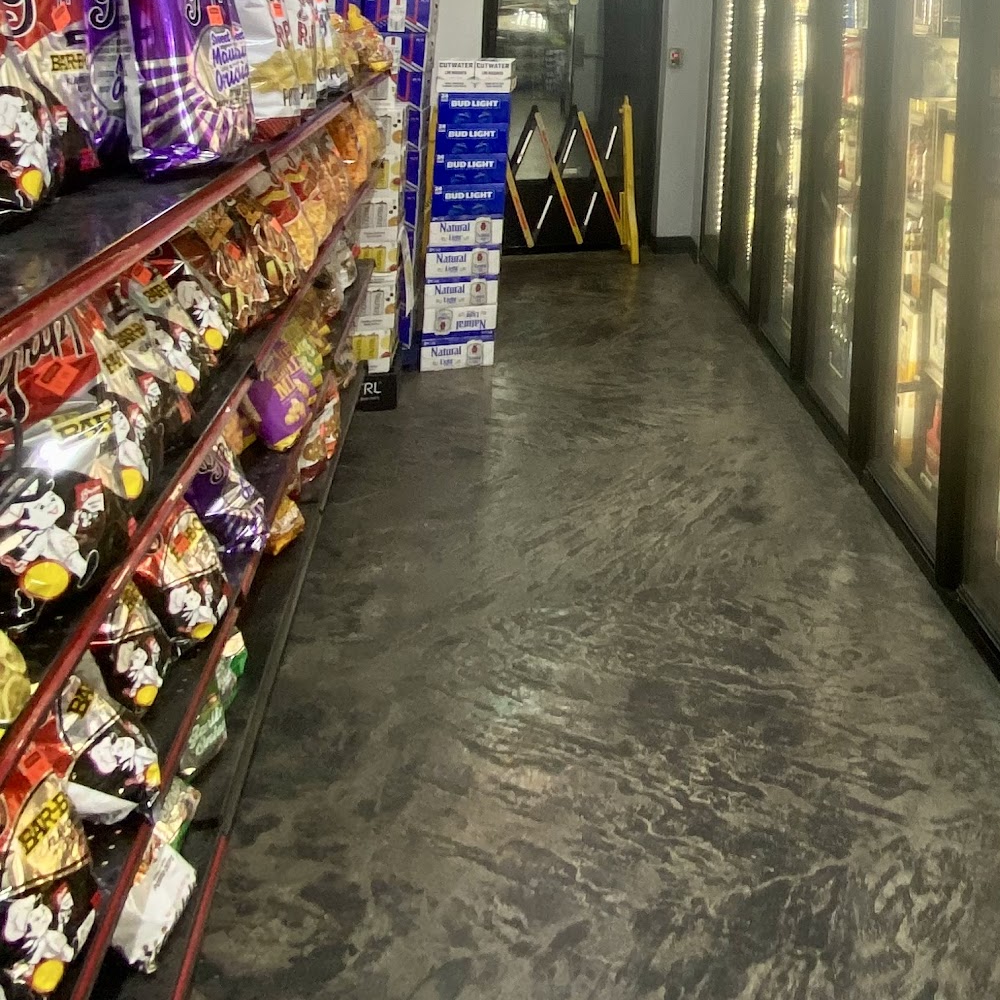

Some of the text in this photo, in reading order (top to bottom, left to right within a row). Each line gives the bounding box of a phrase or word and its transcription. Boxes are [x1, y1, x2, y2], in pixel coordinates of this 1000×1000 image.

[467, 160, 494, 168] LIGHT
[465, 191, 493, 199] LIGHT
[439, 222, 470, 233] Natural
[436, 253, 466, 264] Natural
[434, 284, 465, 295] Natural
[431, 346, 461, 357] Natural
